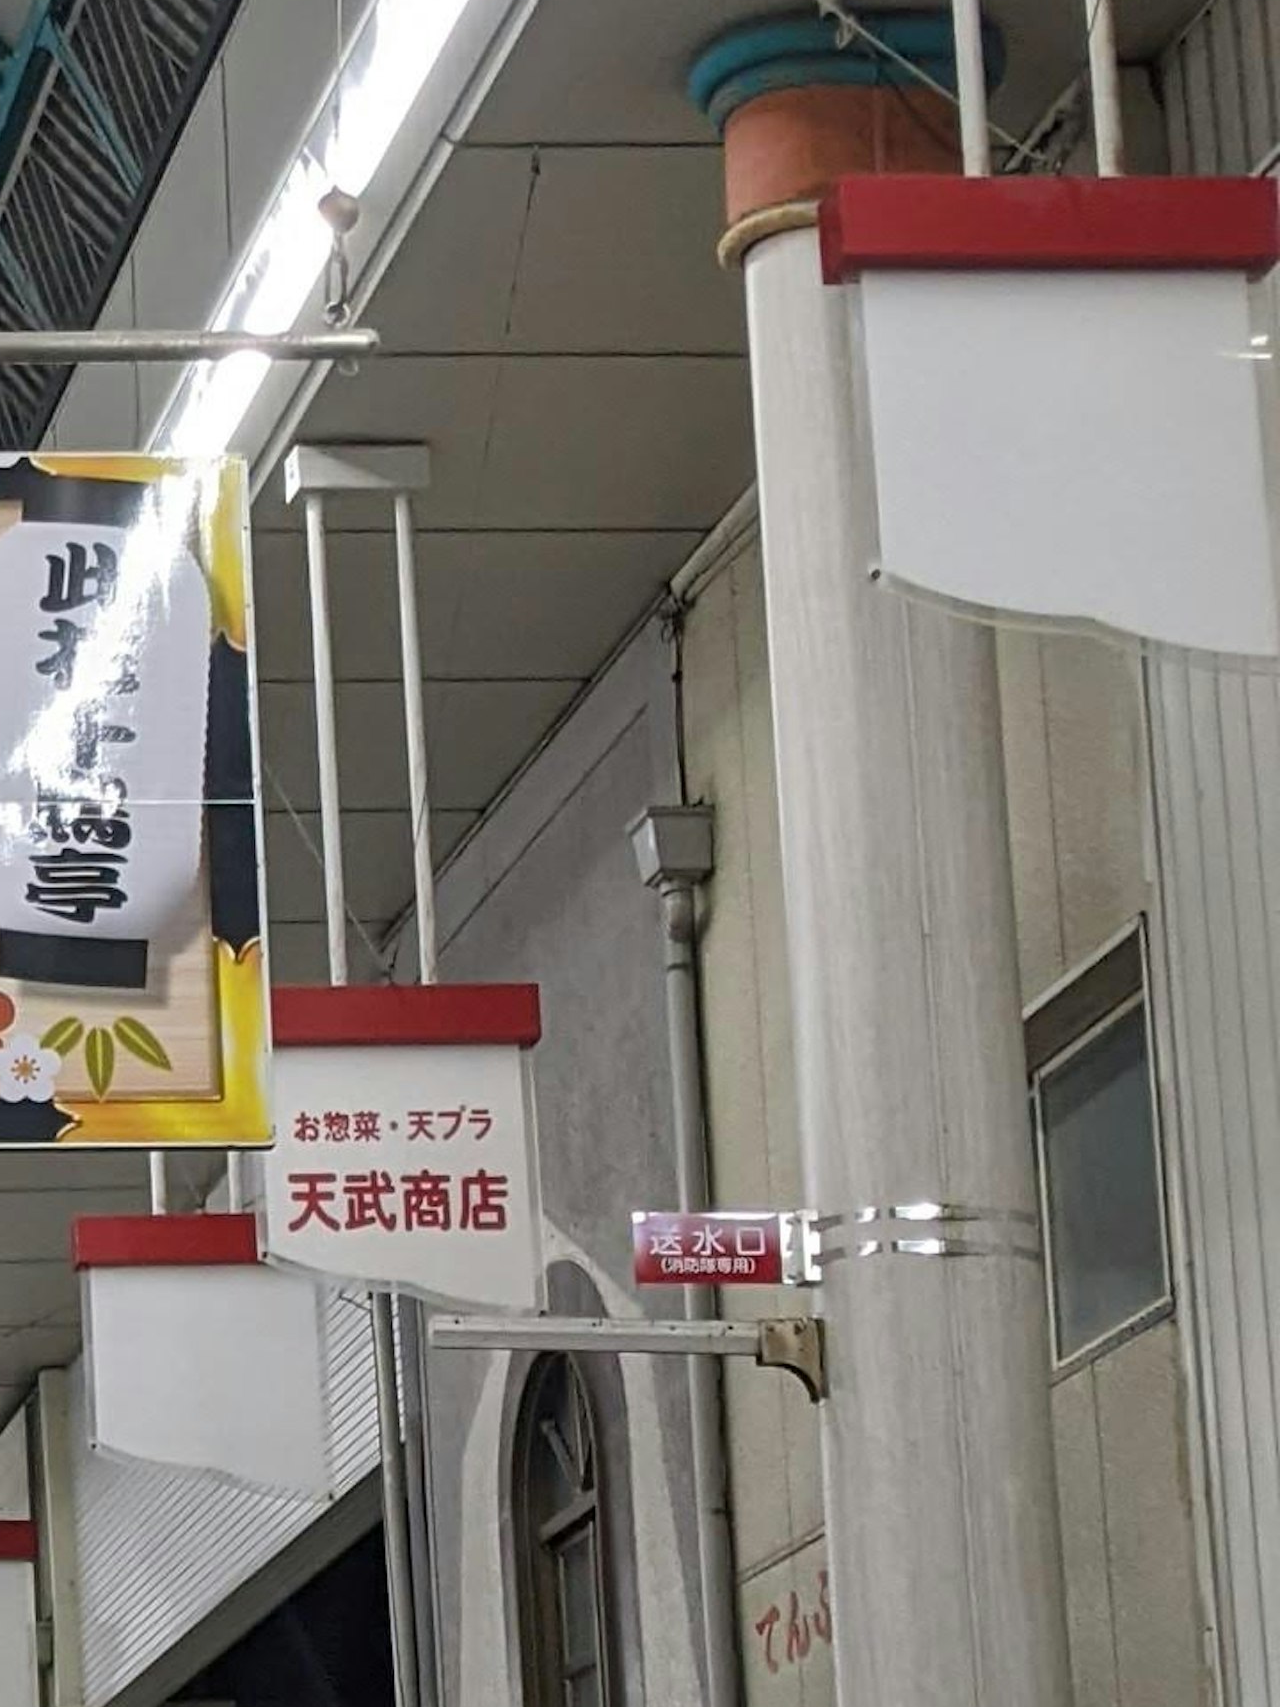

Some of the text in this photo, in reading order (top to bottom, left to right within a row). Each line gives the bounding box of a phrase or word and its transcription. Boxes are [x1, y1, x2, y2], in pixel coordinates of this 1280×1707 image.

[294, 1105, 493, 1141] お惣菜・天プラ
[288, 1169, 508, 1232] 天武商店
[650, 1224, 766, 1255] 送水口
